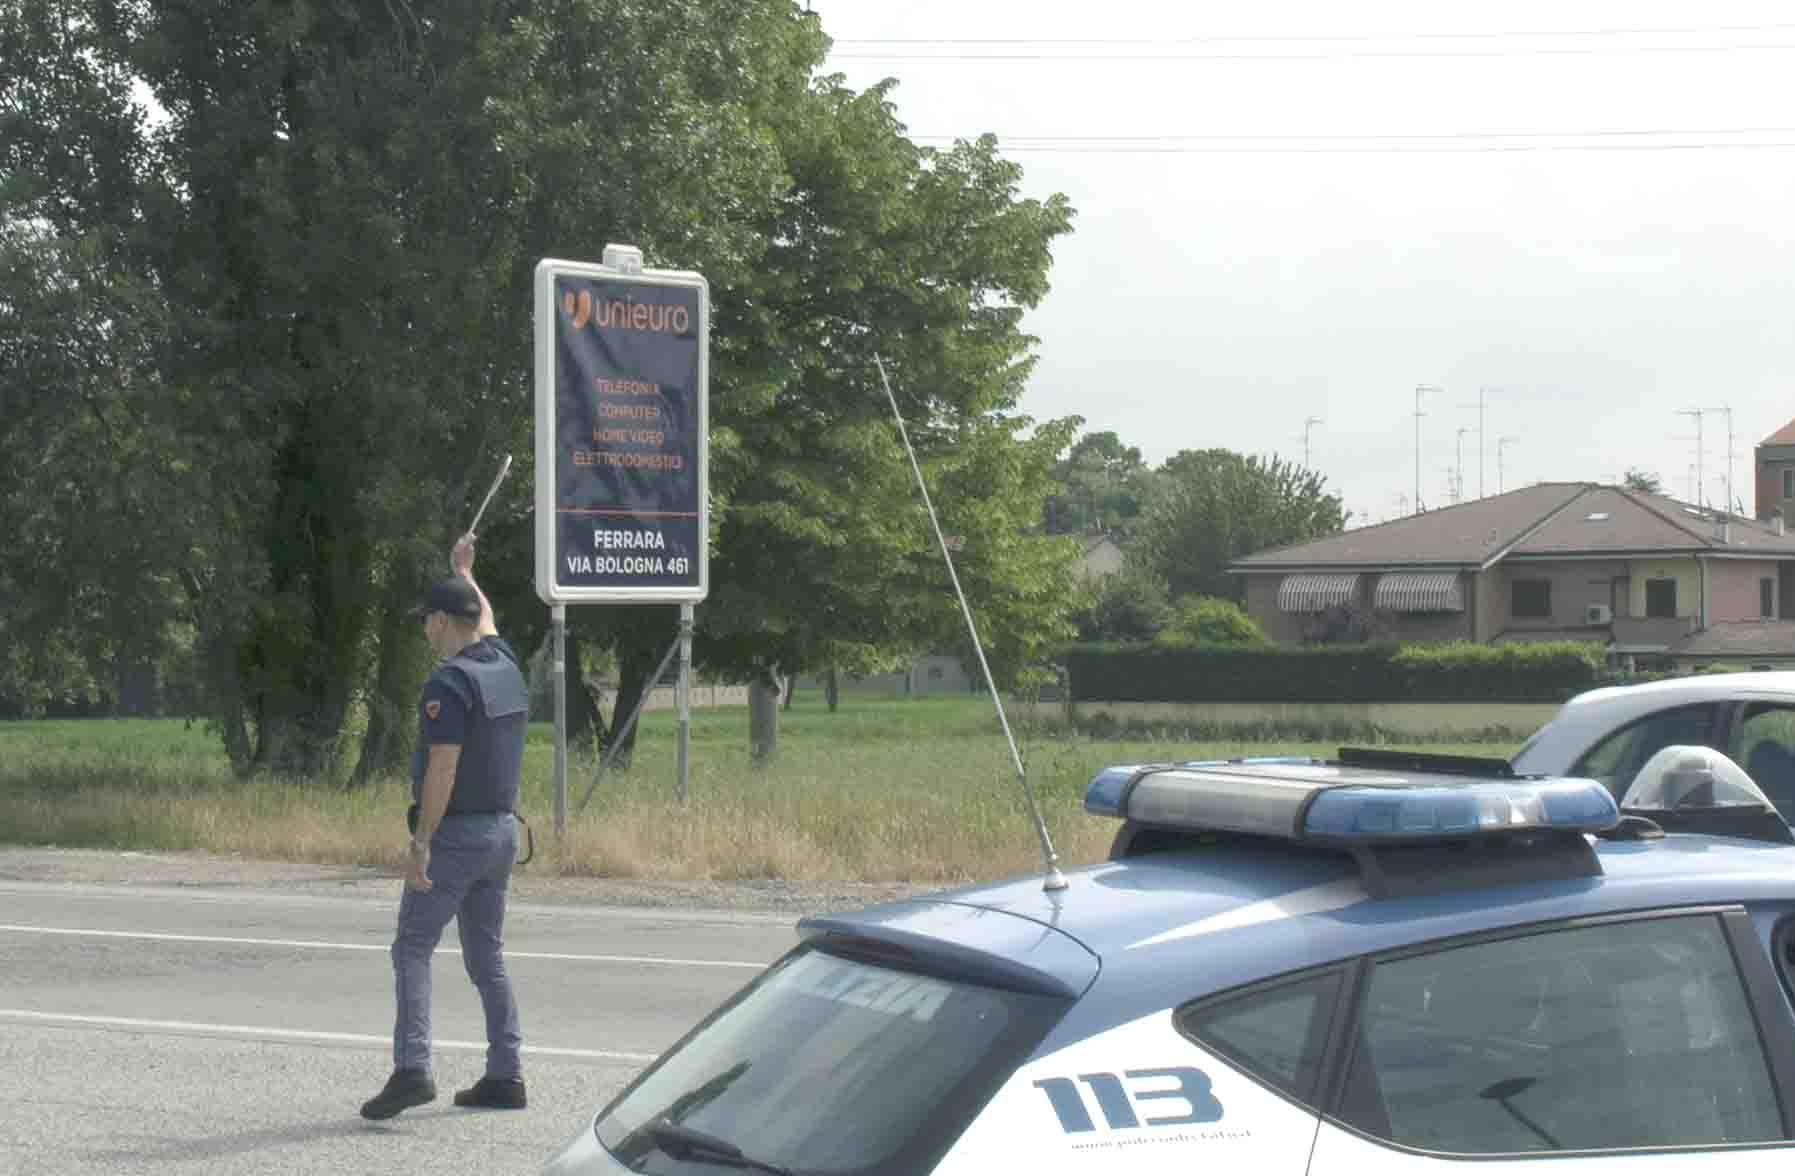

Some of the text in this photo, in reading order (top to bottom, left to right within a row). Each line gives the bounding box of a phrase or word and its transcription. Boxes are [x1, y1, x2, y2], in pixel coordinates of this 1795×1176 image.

[594, 292, 689, 334] unieuro
[594, 530, 665, 549] FERRARA
[567, 556, 689, 575] VIA BOLOGNA 461
[1032, 1066, 1224, 1133] 113
